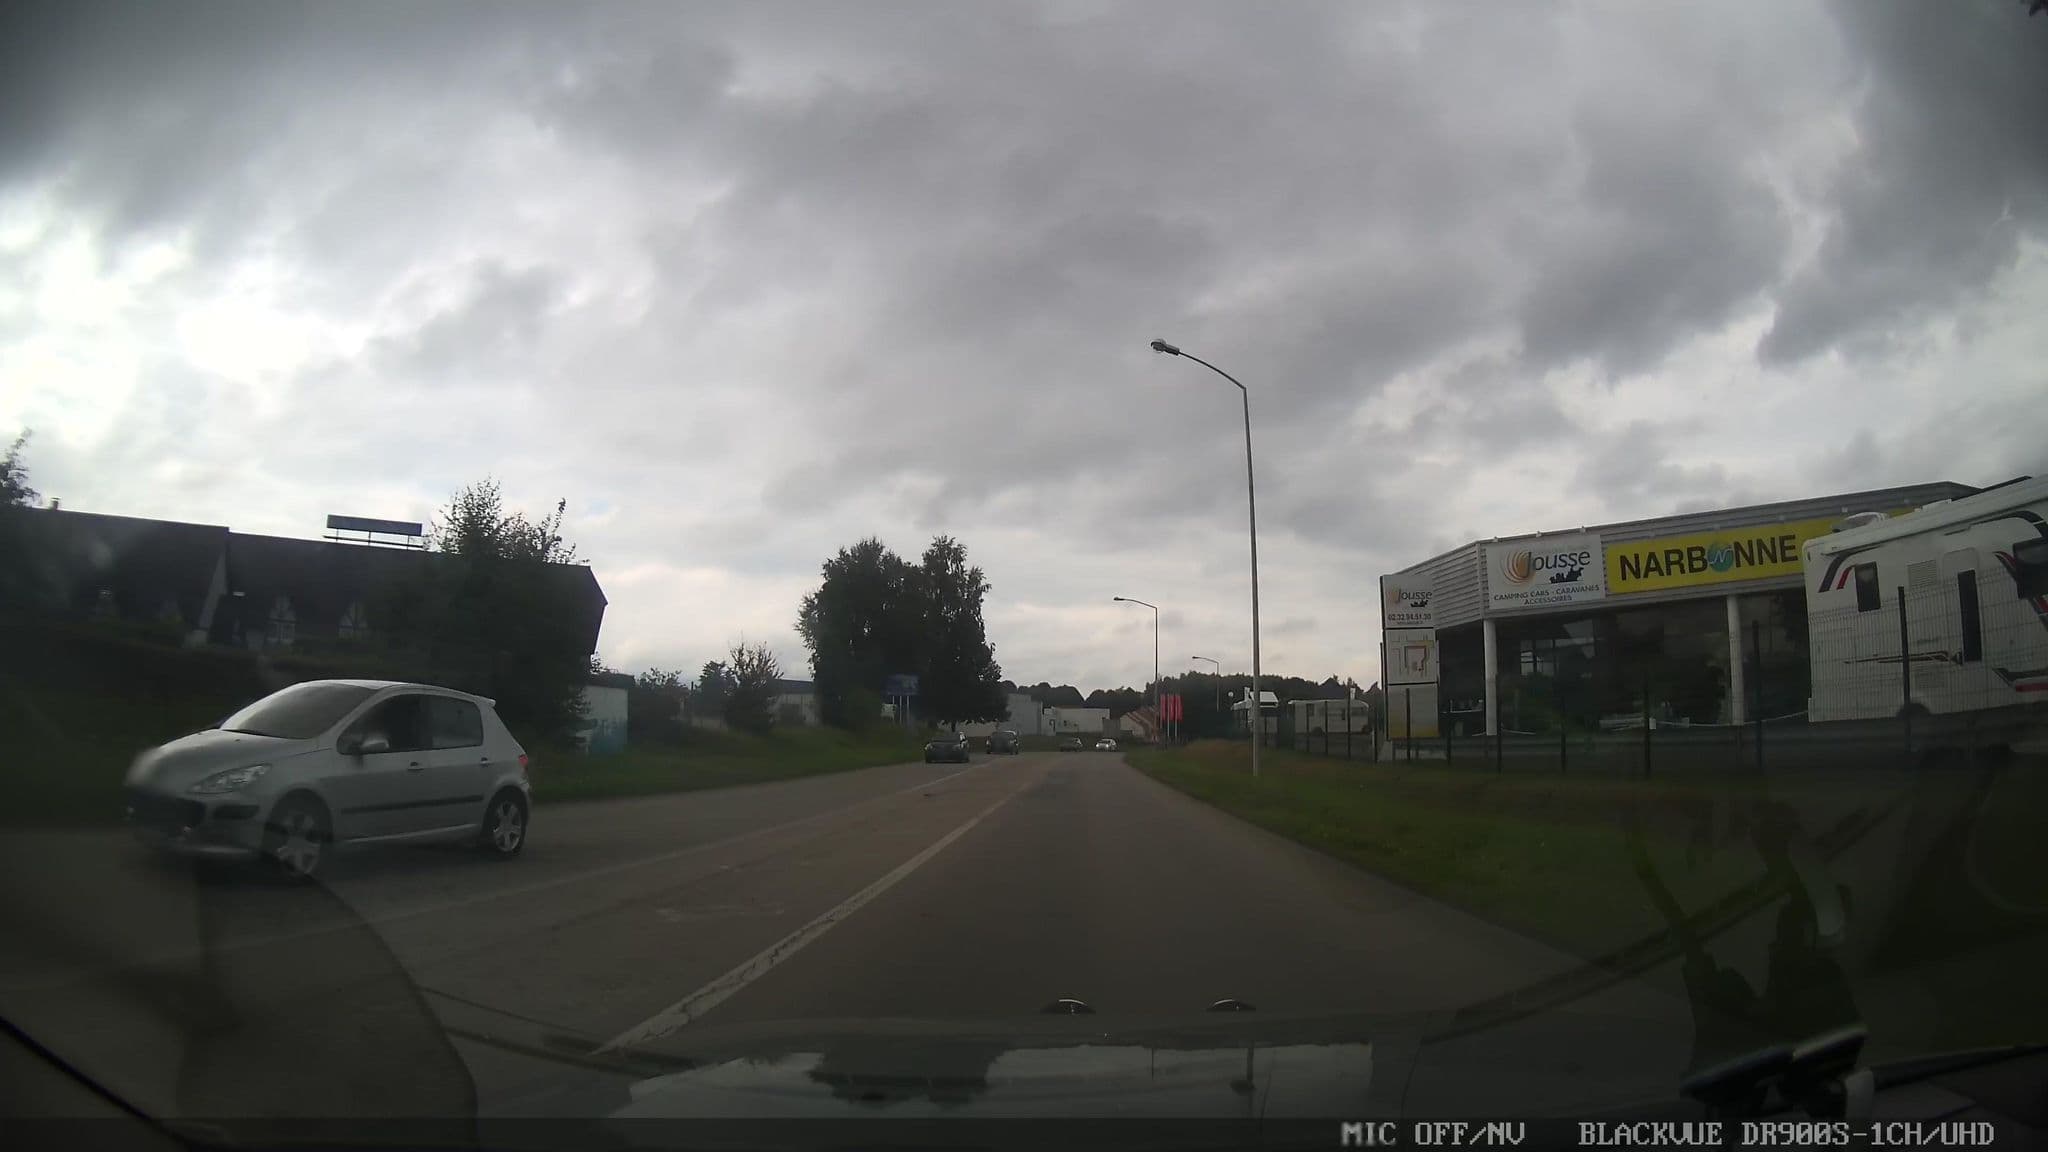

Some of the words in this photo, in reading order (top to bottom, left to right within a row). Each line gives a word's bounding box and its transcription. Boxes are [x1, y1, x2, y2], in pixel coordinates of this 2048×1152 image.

[1494, 591, 1528, 601] CAMPING
[1530, 589, 1550, 597] CARS
[1556, 584, 1600, 595] CARAVANES
[1524, 595, 1572, 605] ACCESSOIRES
